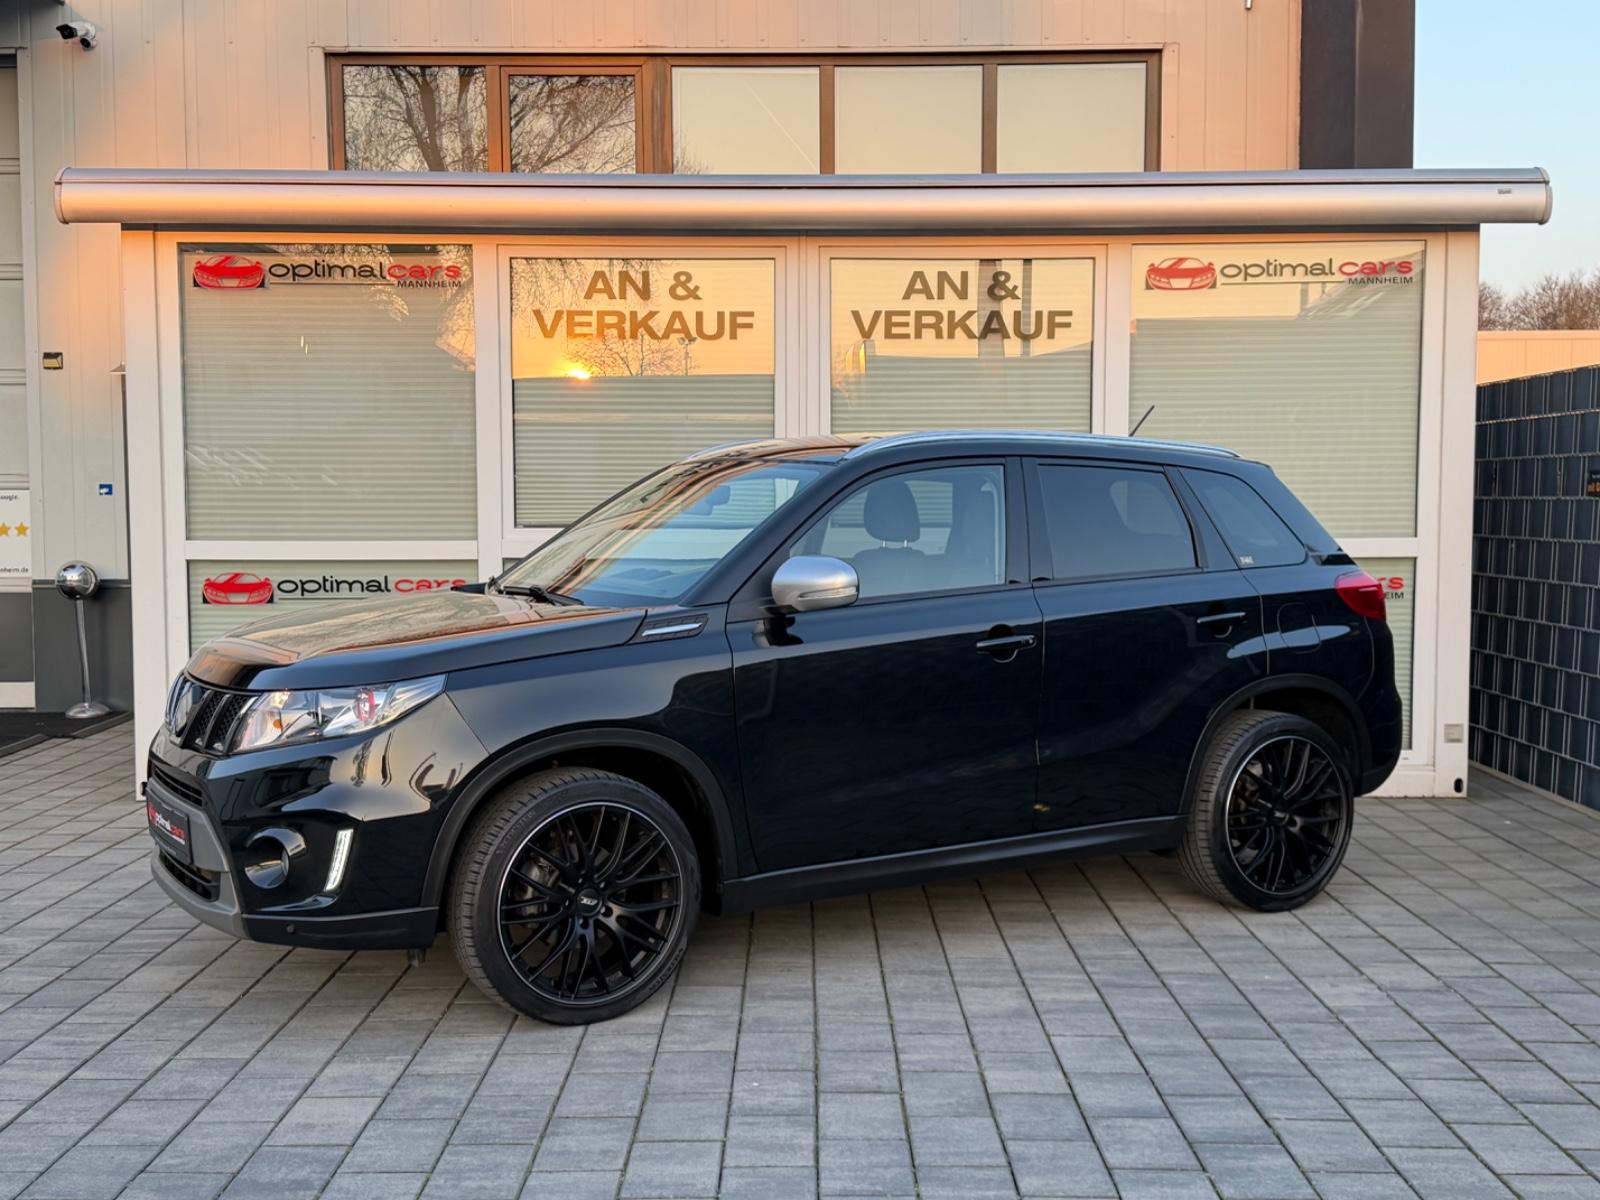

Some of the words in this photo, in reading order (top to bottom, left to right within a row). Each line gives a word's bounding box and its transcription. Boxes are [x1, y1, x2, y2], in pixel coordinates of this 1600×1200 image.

[397, 280, 462, 288] MANNHEIM
[583, 270, 651, 300] AN
[668, 270, 703, 301] &
[902, 270, 969, 300] AN
[986, 270, 1021, 301] &
[1347, 276, 1414, 285] MANNHEIM
[532, 309, 755, 341] VERKAUF
[851, 309, 1073, 340] VERKAUF
